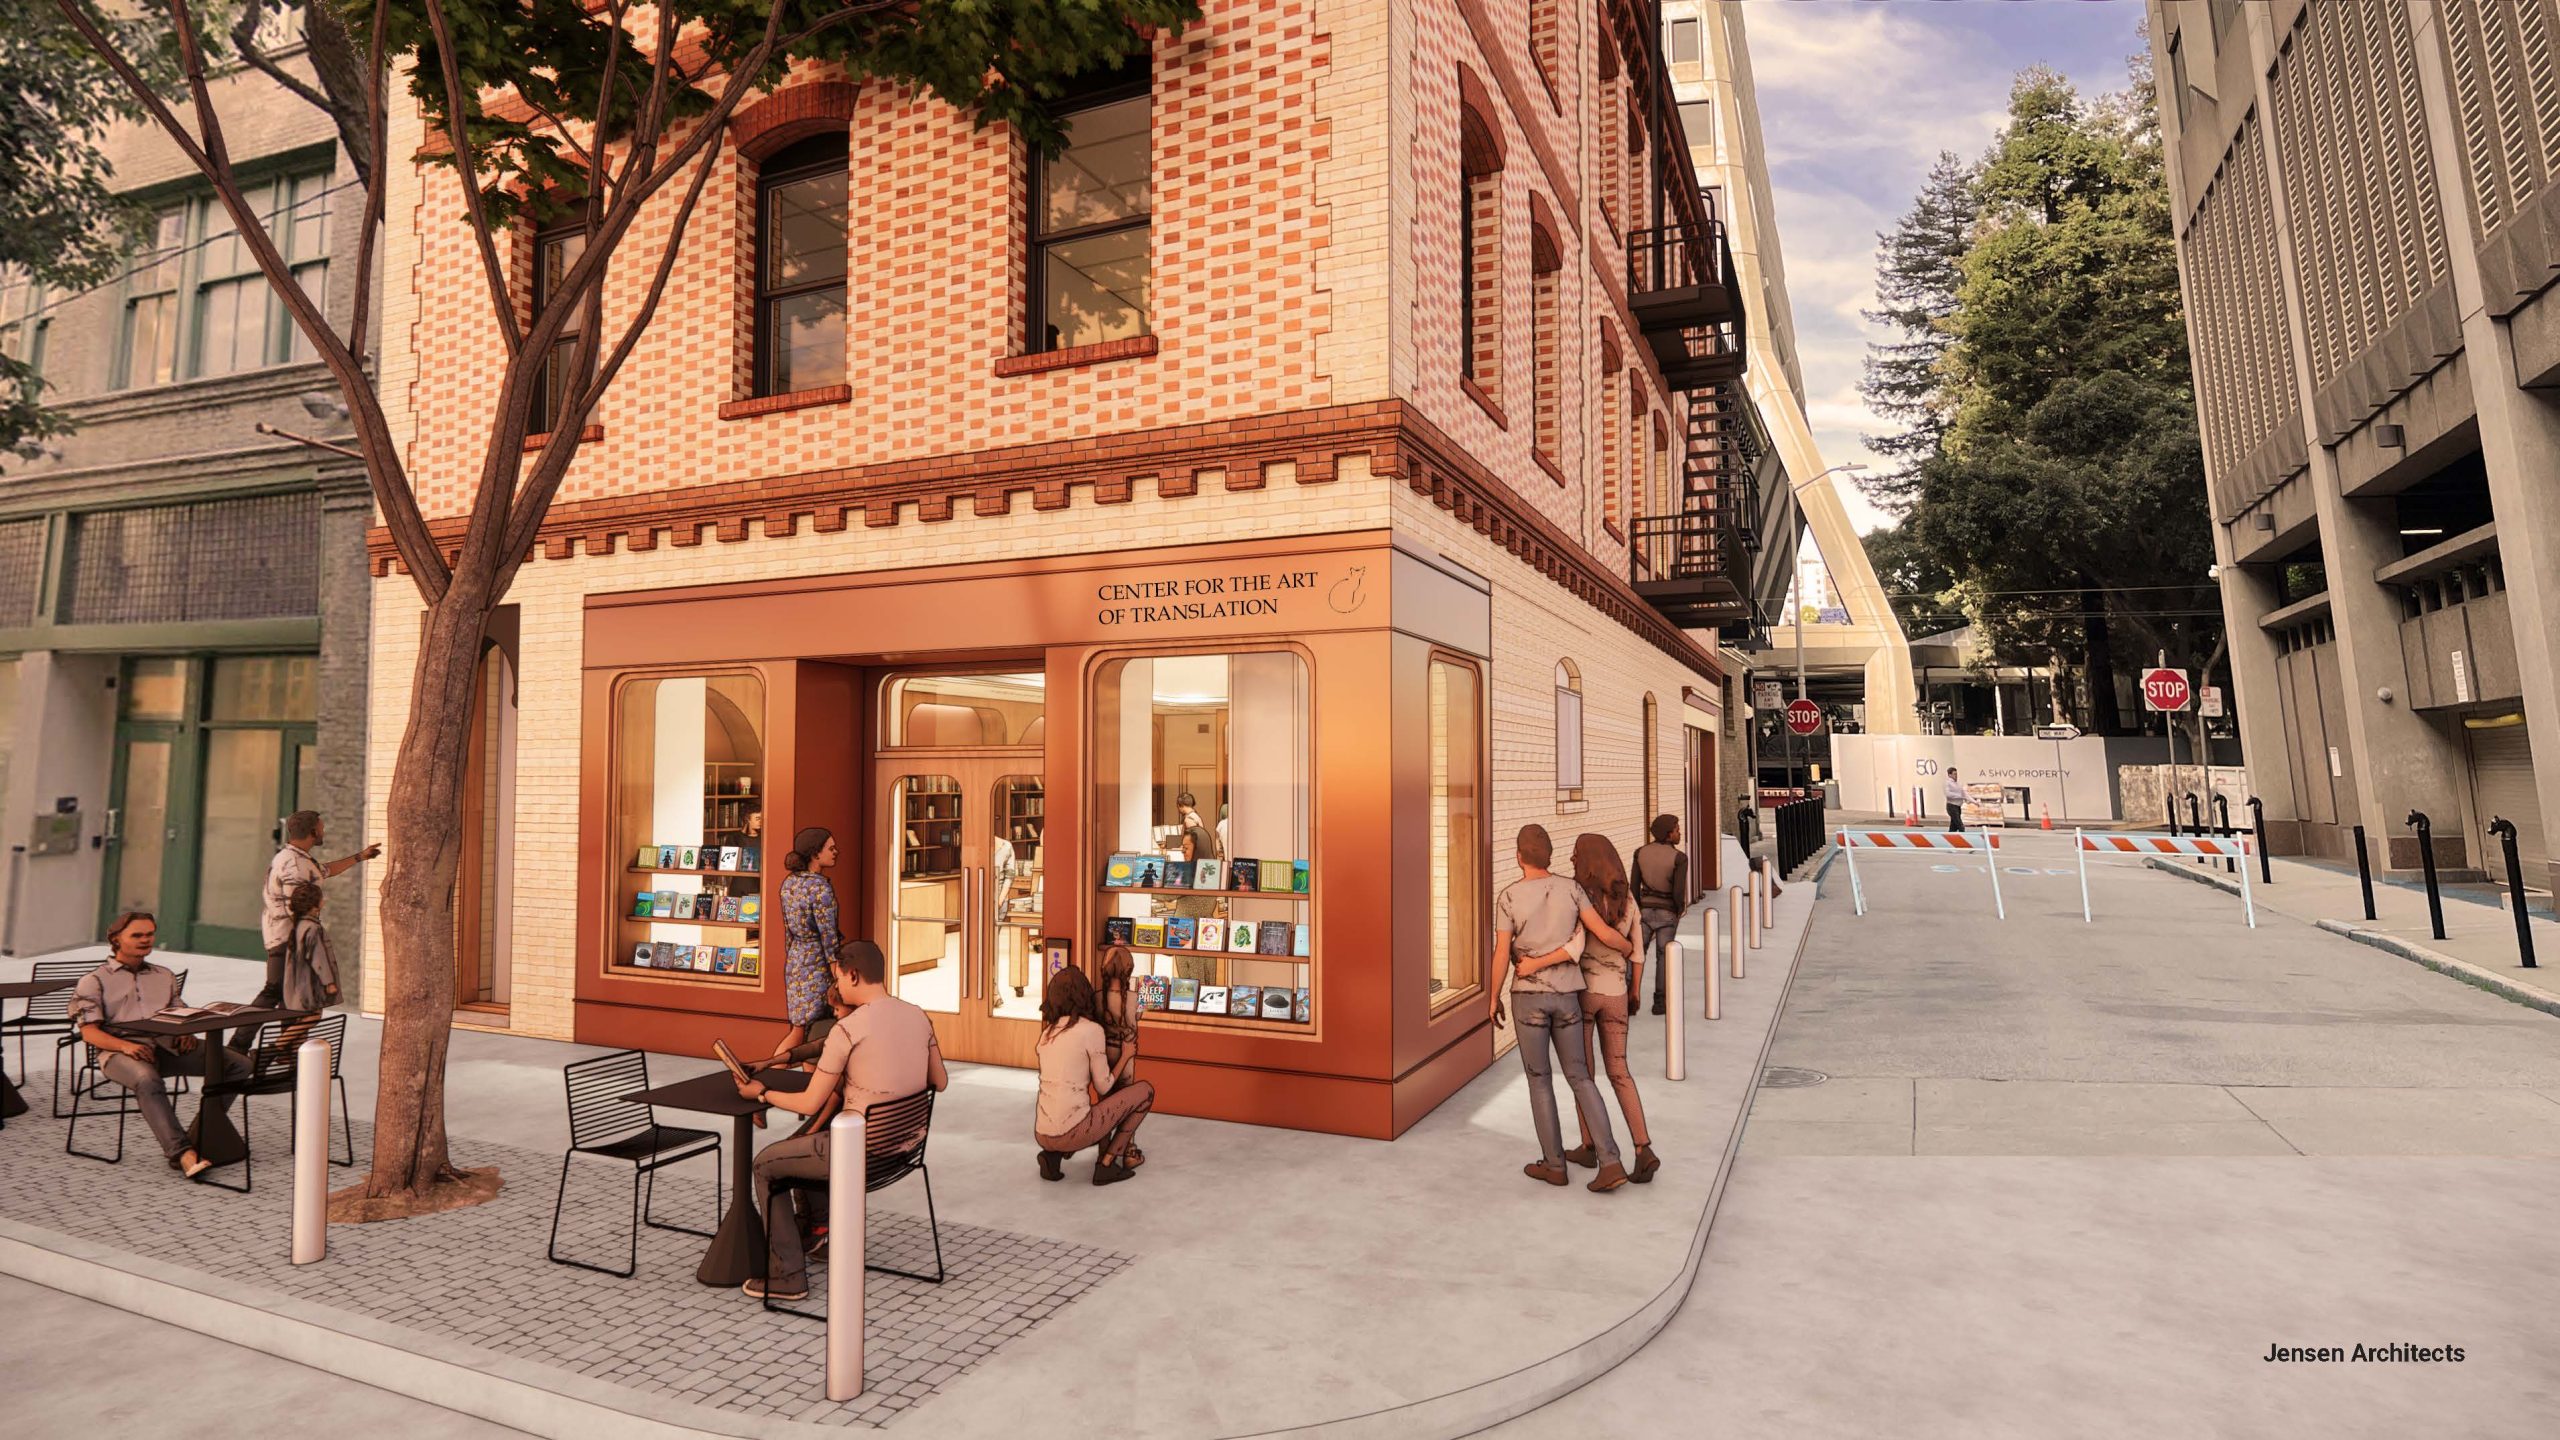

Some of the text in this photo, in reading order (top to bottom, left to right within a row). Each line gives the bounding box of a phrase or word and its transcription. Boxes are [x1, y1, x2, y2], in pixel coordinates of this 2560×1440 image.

[1098, 571, 1318, 601] CENTER FOR THE ART
[1098, 598, 1278, 625] OF TRANSLATION
[2148, 681, 2185, 698] STOP
[1787, 710, 1819, 724] STOP
[1979, 769, 2071, 779] A SHVO PROPERTY
[1139, 985, 1165, 995] SLEEP
[1138, 994, 1166, 1003] PHASE
